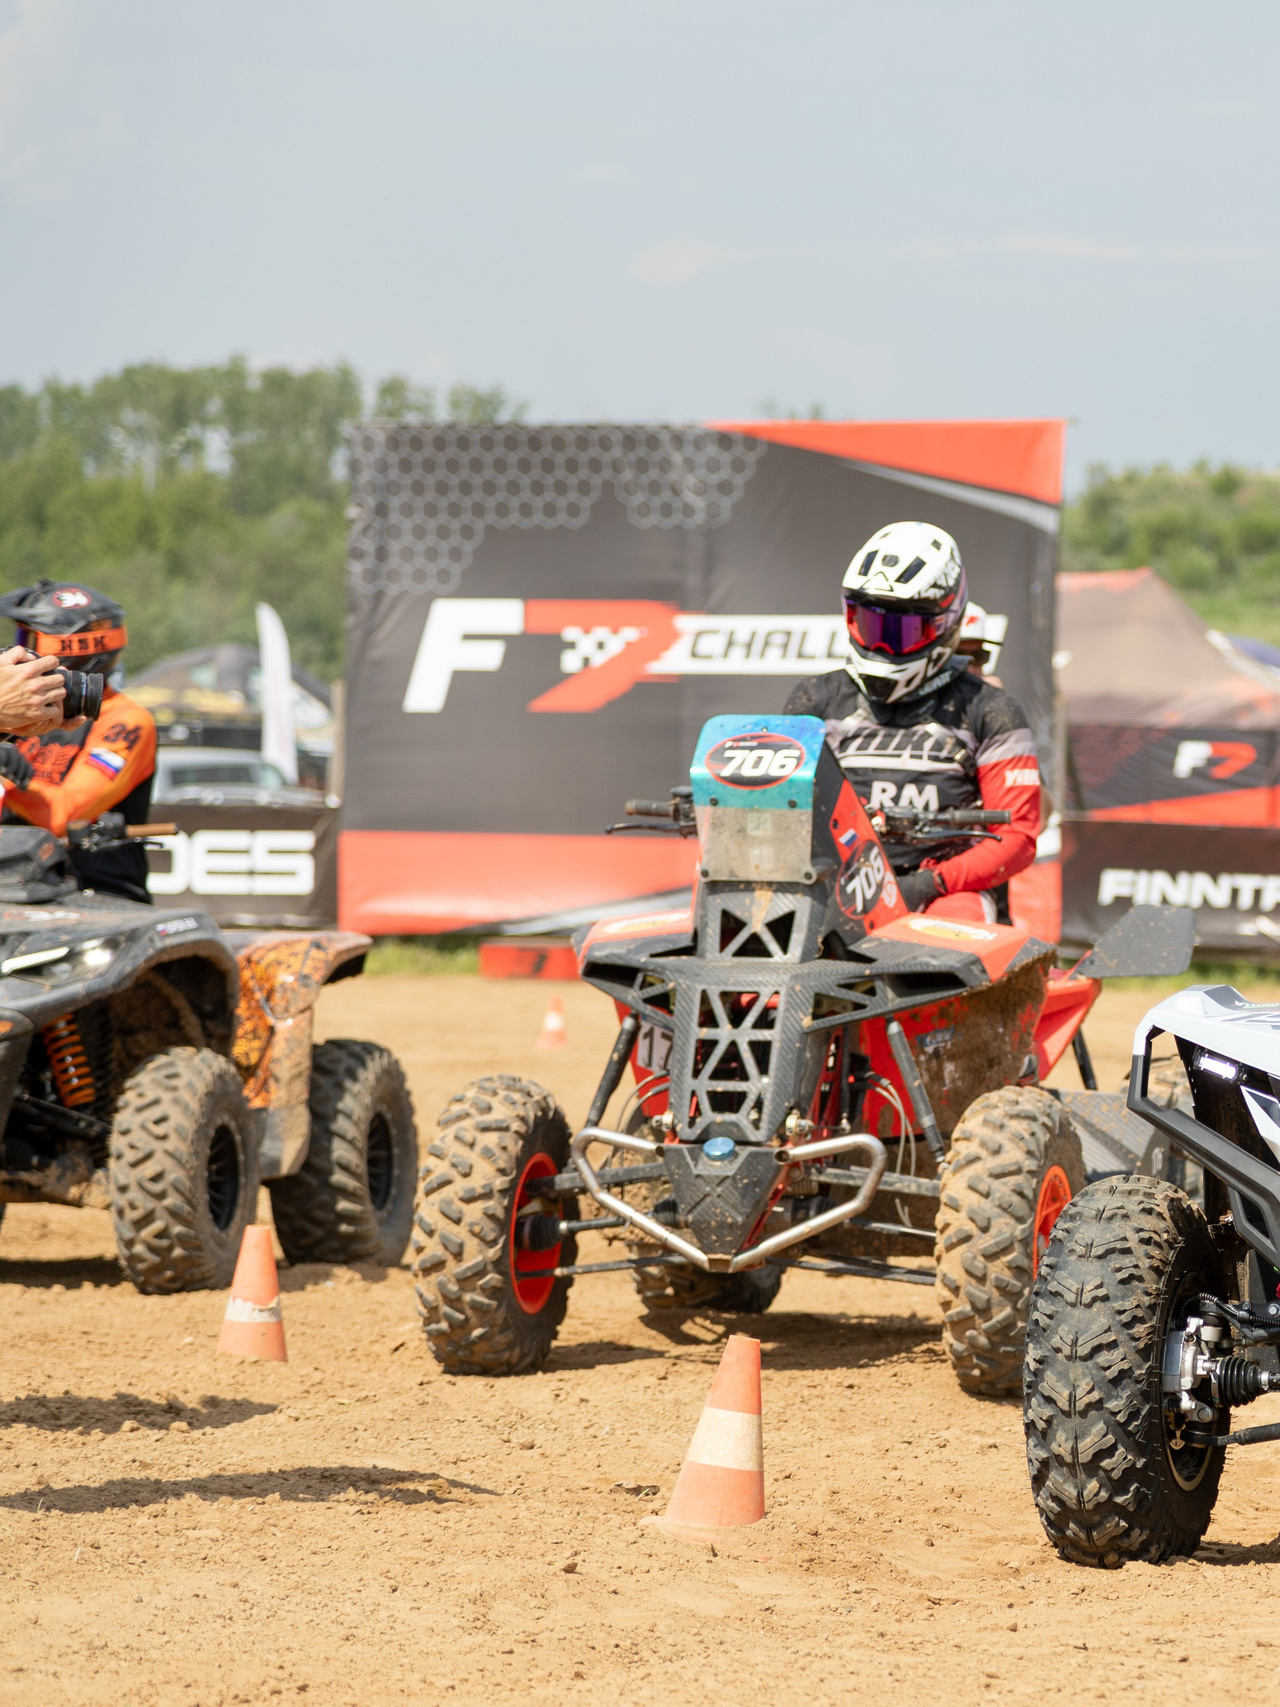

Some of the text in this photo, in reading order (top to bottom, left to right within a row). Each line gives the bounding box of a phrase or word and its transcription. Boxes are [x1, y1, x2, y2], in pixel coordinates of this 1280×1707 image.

[690, 629, 853, 660] CHALL
[103, 723, 142, 752] 34
[719, 749, 801, 777] 706
[1173, 740, 1257, 780] F7
[870, 780, 940, 812] RM
[146, 829, 316, 895] DES
[846, 845, 884, 913] 706
